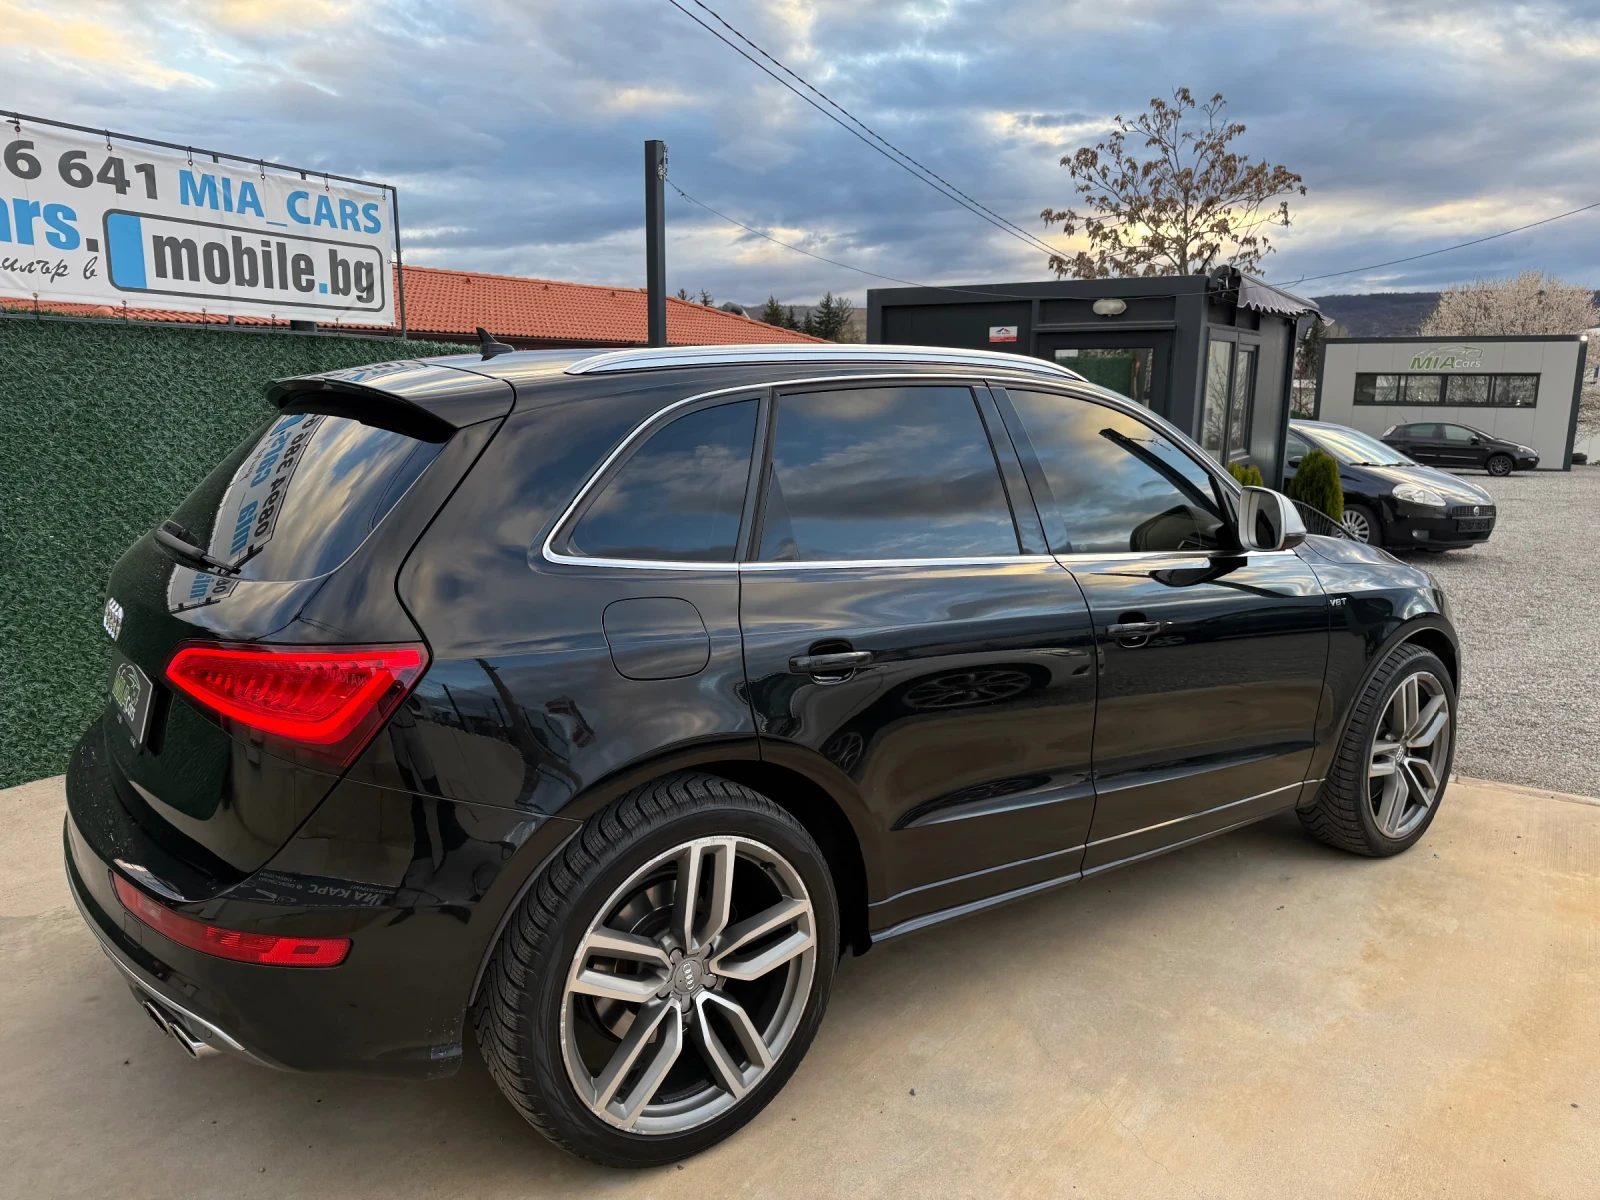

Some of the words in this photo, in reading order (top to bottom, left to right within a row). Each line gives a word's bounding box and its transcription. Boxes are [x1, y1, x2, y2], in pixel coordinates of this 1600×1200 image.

[0, 140, 42, 180] 6
[58, 150, 158, 200] 641
[178, 169, 382, 235] MIA_CARS
[0, 257, 70, 283] илър
[152, 235, 375, 303] mobile.bg
[1409, 356, 1456, 370] MIA
[1455, 359, 1481, 368] Cars
